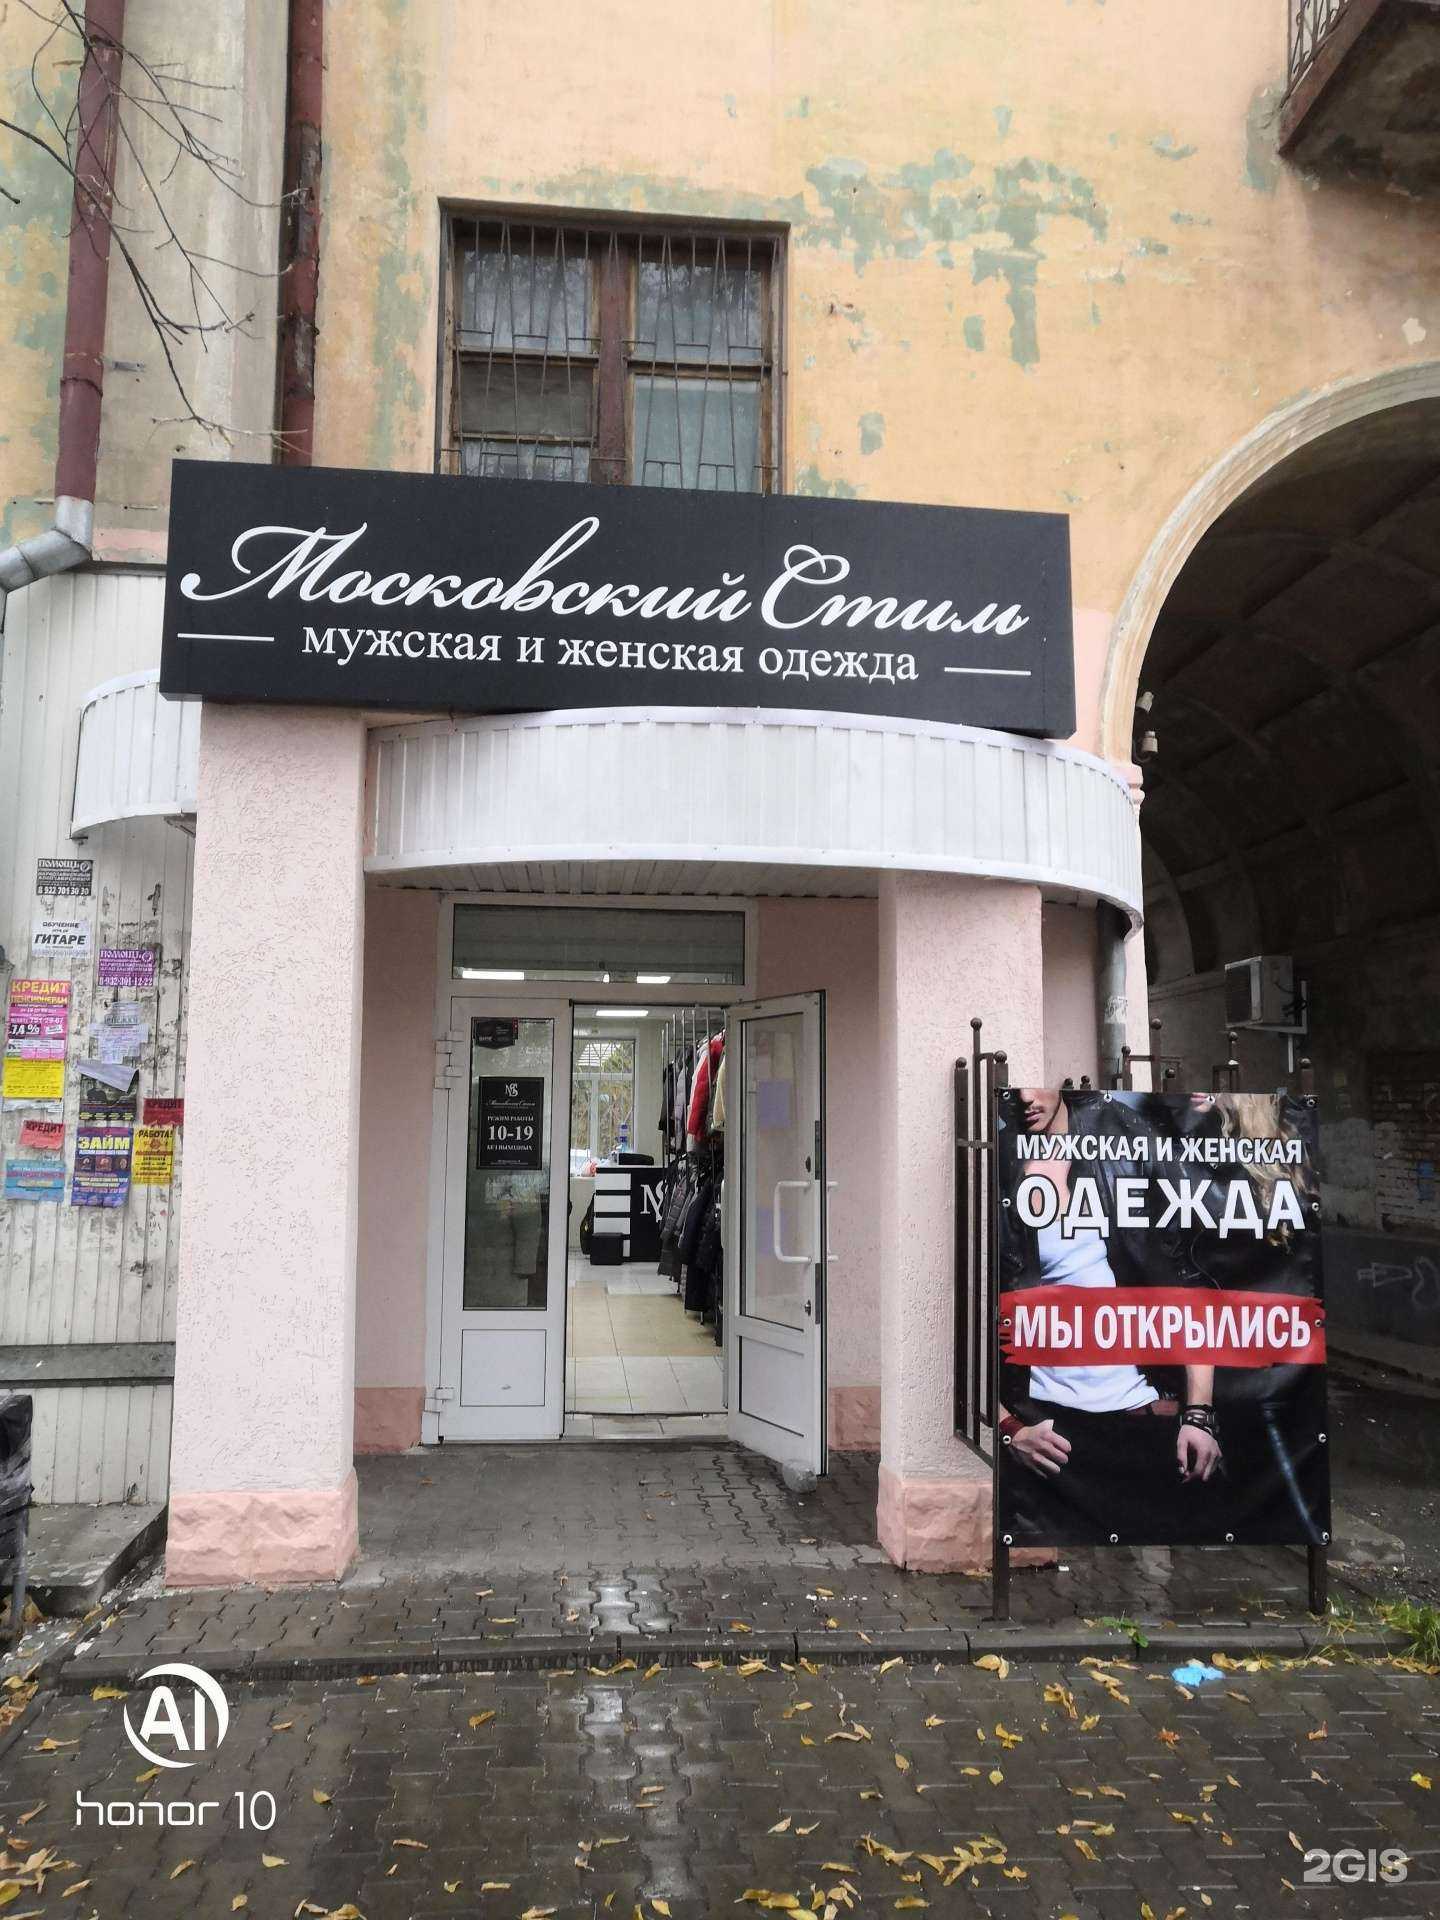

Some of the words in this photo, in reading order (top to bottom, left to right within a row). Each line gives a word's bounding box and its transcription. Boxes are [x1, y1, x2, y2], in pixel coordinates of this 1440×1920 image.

[180, 516, 751, 622] Московский
[761, 544, 1030, 636] Стиль
[301, 626, 502, 666] мужская
[517, 636, 545, 664] и
[557, 638, 744, 673] женская
[758, 645, 919, 685] одежда
[34, 934, 87, 945] ГИТАРЕ
[11, 981, 70, 995] КРЕДИТ
[25, 1120, 64, 1133] КРЕДИТ
[138, 1129, 173, 1138] РАБОТА!
[488, 1125, 534, 1141] 10-19
[78, 1134, 130, 1150] ЗАЙМ
[1016, 1134, 1149, 1161] МУЖСКАЯ
[1156, 1136, 1173, 1162] И
[1180, 1137, 1302, 1164] ЖЕНСКАЯ
[1016, 1175, 1306, 1240] ОДЕЖДА
[1014, 1305, 1083, 1349] МЫ
[1094, 1305, 1311, 1349] ОТКРЫЛИСЬ
